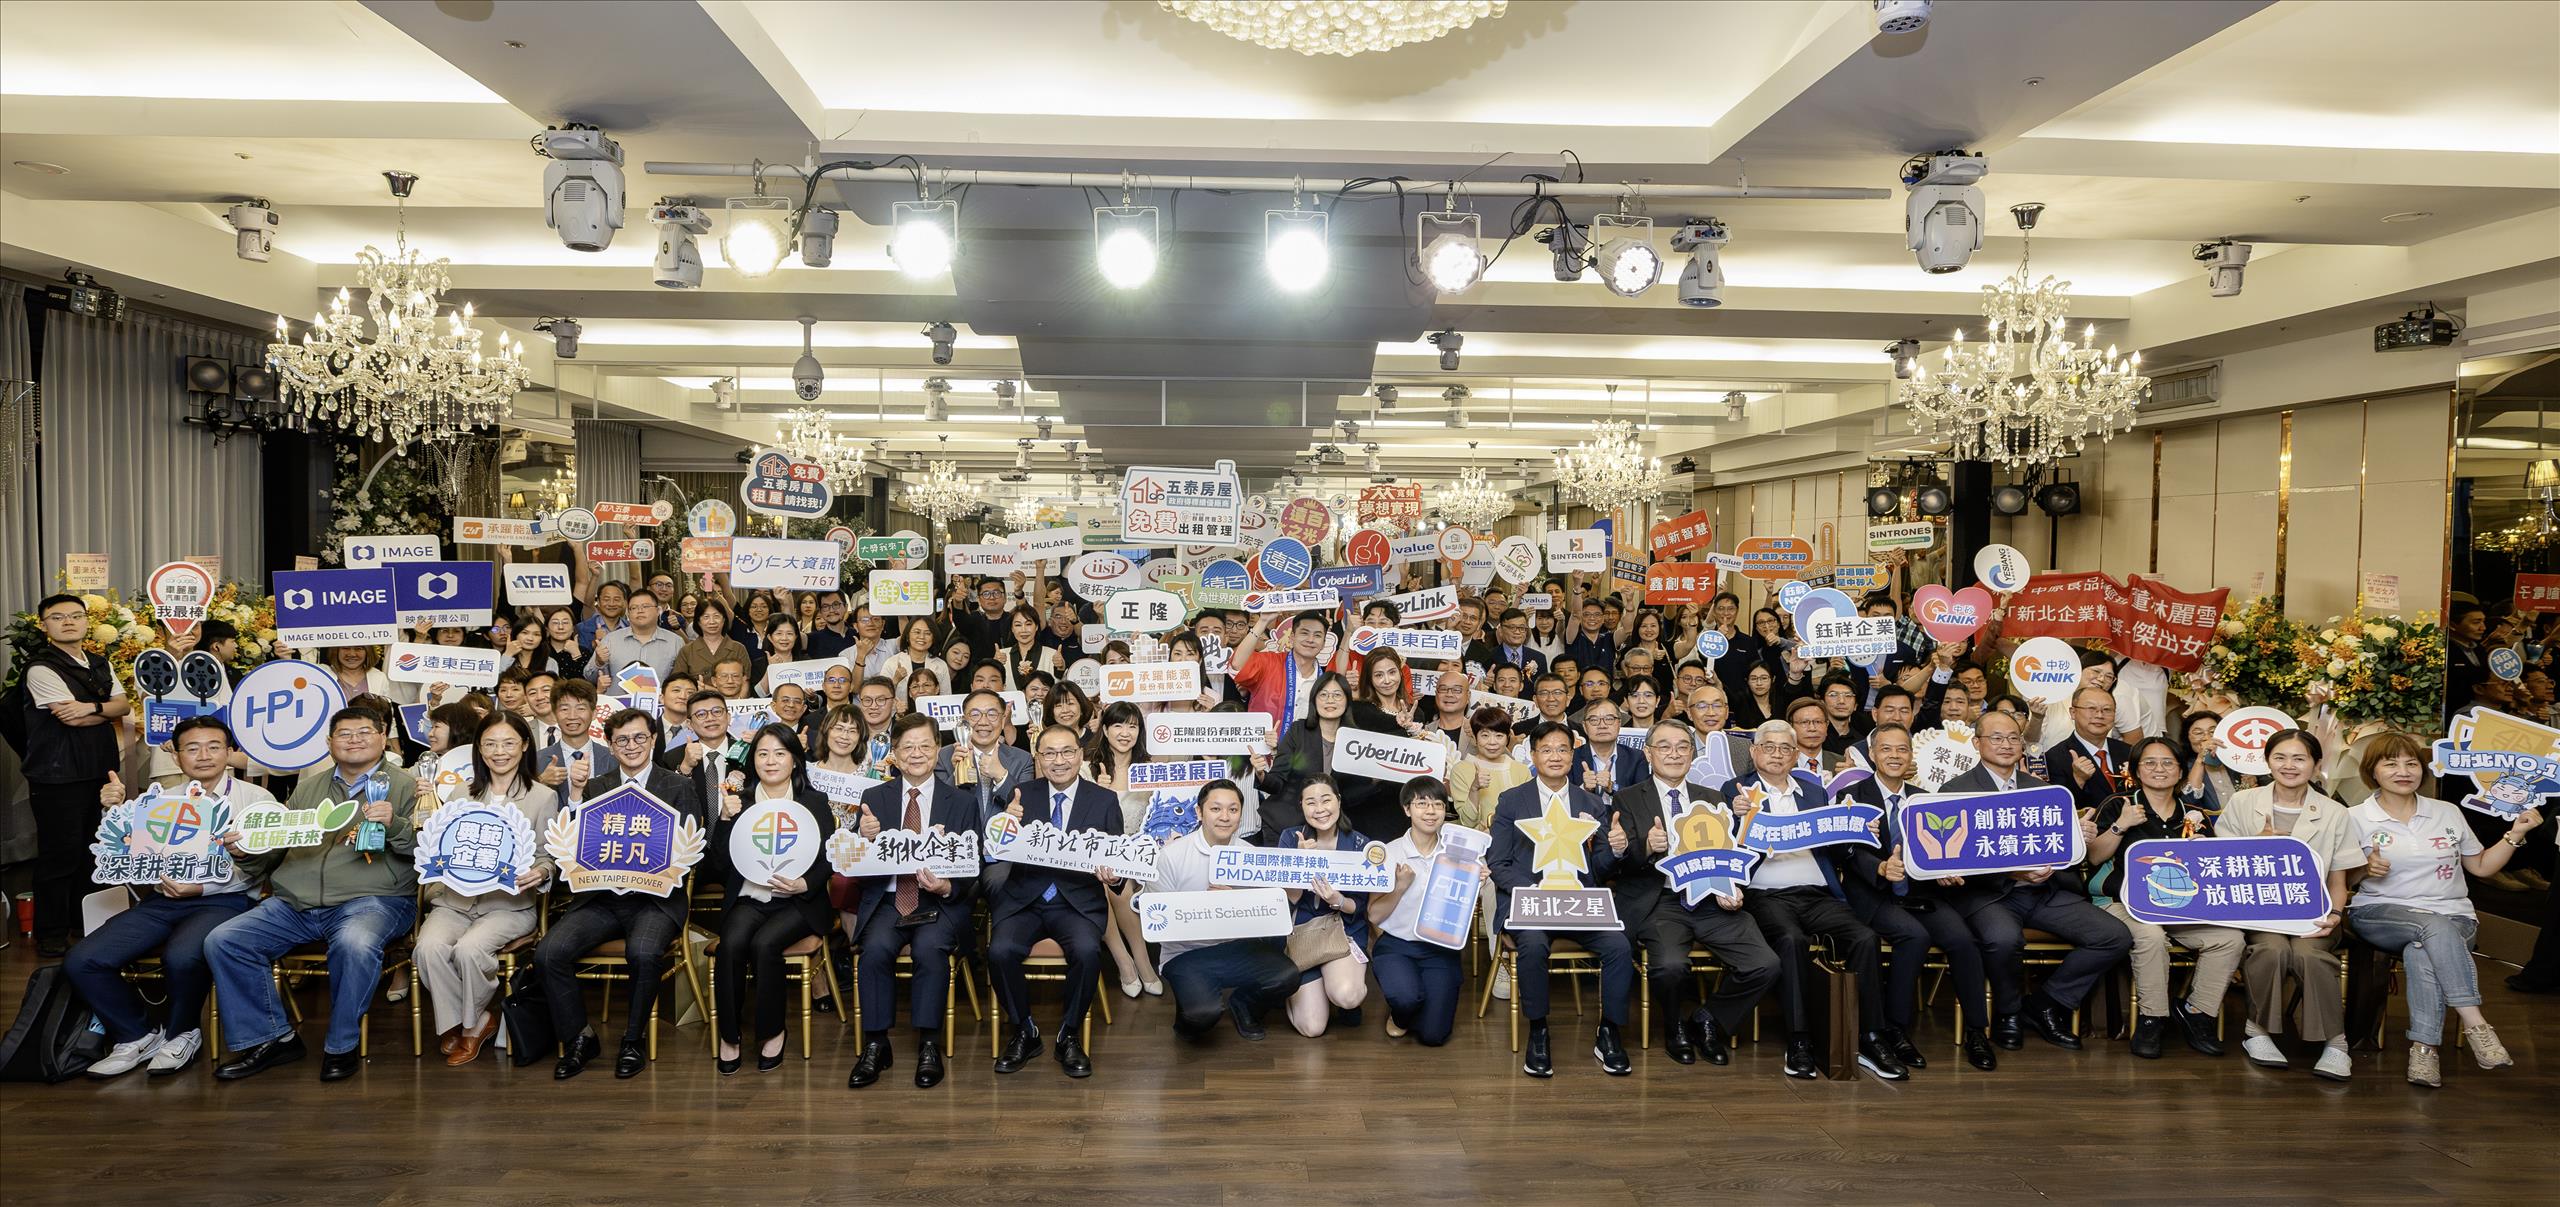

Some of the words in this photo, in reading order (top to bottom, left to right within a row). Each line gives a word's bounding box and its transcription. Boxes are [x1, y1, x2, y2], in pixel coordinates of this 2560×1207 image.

[793, 465, 821, 482] 免費
[763, 477, 814, 494] 五泰房屋
[1166, 480, 1232, 497] 五泰房屋
[1359, 500, 1420, 516] 夢想實現
[1129, 508, 1178, 535] 免費
[1178, 522, 1232, 537] 出租管理
[1653, 522, 1709, 549] 創新智慧
[1869, 526, 1932, 539] SINTRONES
[382, 546, 435, 558] IMAGE
[1031, 538, 1075, 549] HULANE
[765, 553, 836, 571] 仁大資訊
[970, 554, 1014, 565] LITEMAX
[1263, 549, 1308, 580] 遠百
[1550, 552, 1603, 561] SINTRONES
[1998, 548, 2013, 582] YESIANG
[511, 575, 565, 589] ATEN
[802, 574, 836, 587] 7767
[1317, 572, 1369, 587] CyberLink
[1649, 576, 1712, 591] 鑫創電子
[322, 589, 388, 606] IMAGE
[1199, 591, 1244, 605] 為世界的
[1268, 589, 1336, 605] 遠東百貨
[157, 605, 205, 619] 我最棒
[1120, 601, 1168, 621] 正隆
[1953, 605, 1975, 615] 中砂
[1935, 614, 1977, 625] KINIK
[284, 632, 315, 642] IMAGE
[316, 631, 349, 641] MODEL
[352, 630, 372, 640] CO.,
[373, 630, 392, 639] LTD.
[1815, 618, 1895, 639] 鈺祥企業
[1381, 631, 1459, 651] 遠東百貨
[1702, 641, 1724, 651] NO.1
[1799, 642, 1897, 658] 最得力的ESG夥伴
[423, 655, 494, 673] 遠東百貨
[2046, 660, 2071, 671] 中砂
[2031, 672, 2076, 683] KINIK
[1173, 726, 1266, 736] 正隆股份有限公司
[1345, 739, 1427, 768] CyberLink
[1130, 761, 1226, 784] 經濟發展局
[812, 781, 843, 795] Spirit
[243, 810, 316, 829] 綠色驅動
[601, 811, 653, 838] 精典
[1973, 805, 2064, 830] 創新領航
[248, 829, 322, 849] 低碳未來
[1692, 820, 1714, 848] 1
[876, 831, 966, 865] 新北企業
[1026, 824, 1158, 867] 新北市政府
[1975, 831, 2065, 857] 永續未來
[450, 844, 500, 870] 企業
[599, 840, 650, 866] 非凡
[1242, 853, 1330, 870] 與國際標準接軌
[101, 853, 230, 881] 深耕新北
[1026, 854, 1045, 863] New
[1049, 857, 1078, 869] Taipei
[1107, 865, 1157, 880] overnment
[1673, 855, 1745, 879] 叫我第一名
[2198, 853, 2306, 878] 深耕新北
[578, 875, 601, 885] NEW
[602, 875, 630, 885] TAIPEI
[631, 877, 663, 889] POWER
[2202, 882, 2311, 907] 放眼國際
[1174, 908, 1213, 923] Spirit
[1214, 904, 1278, 919] Scientific
[1520, 895, 1606, 918] 新北之星
